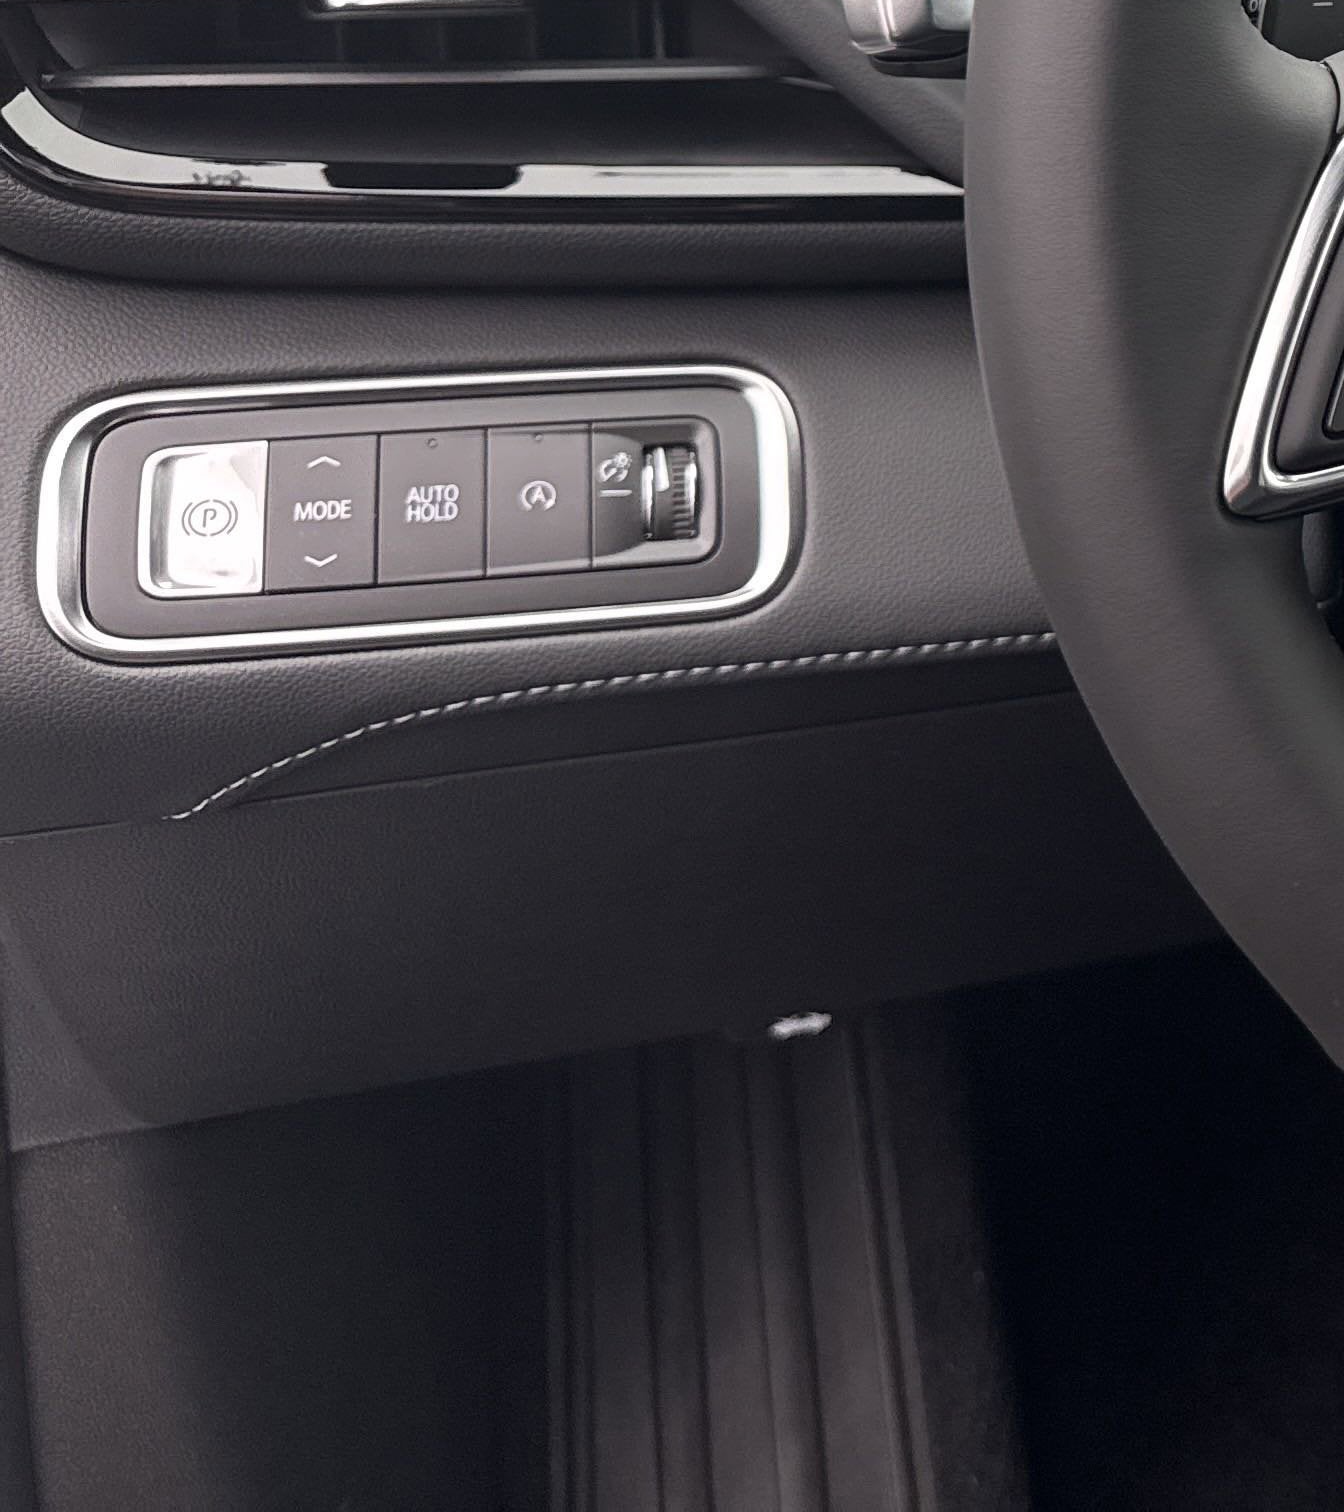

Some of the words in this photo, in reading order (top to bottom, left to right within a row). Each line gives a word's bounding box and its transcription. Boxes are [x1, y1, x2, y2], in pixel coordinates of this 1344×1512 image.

[406, 483, 459, 504] AUTO
[293, 499, 352, 522] MODE
[405, 501, 458, 523] HOLD
